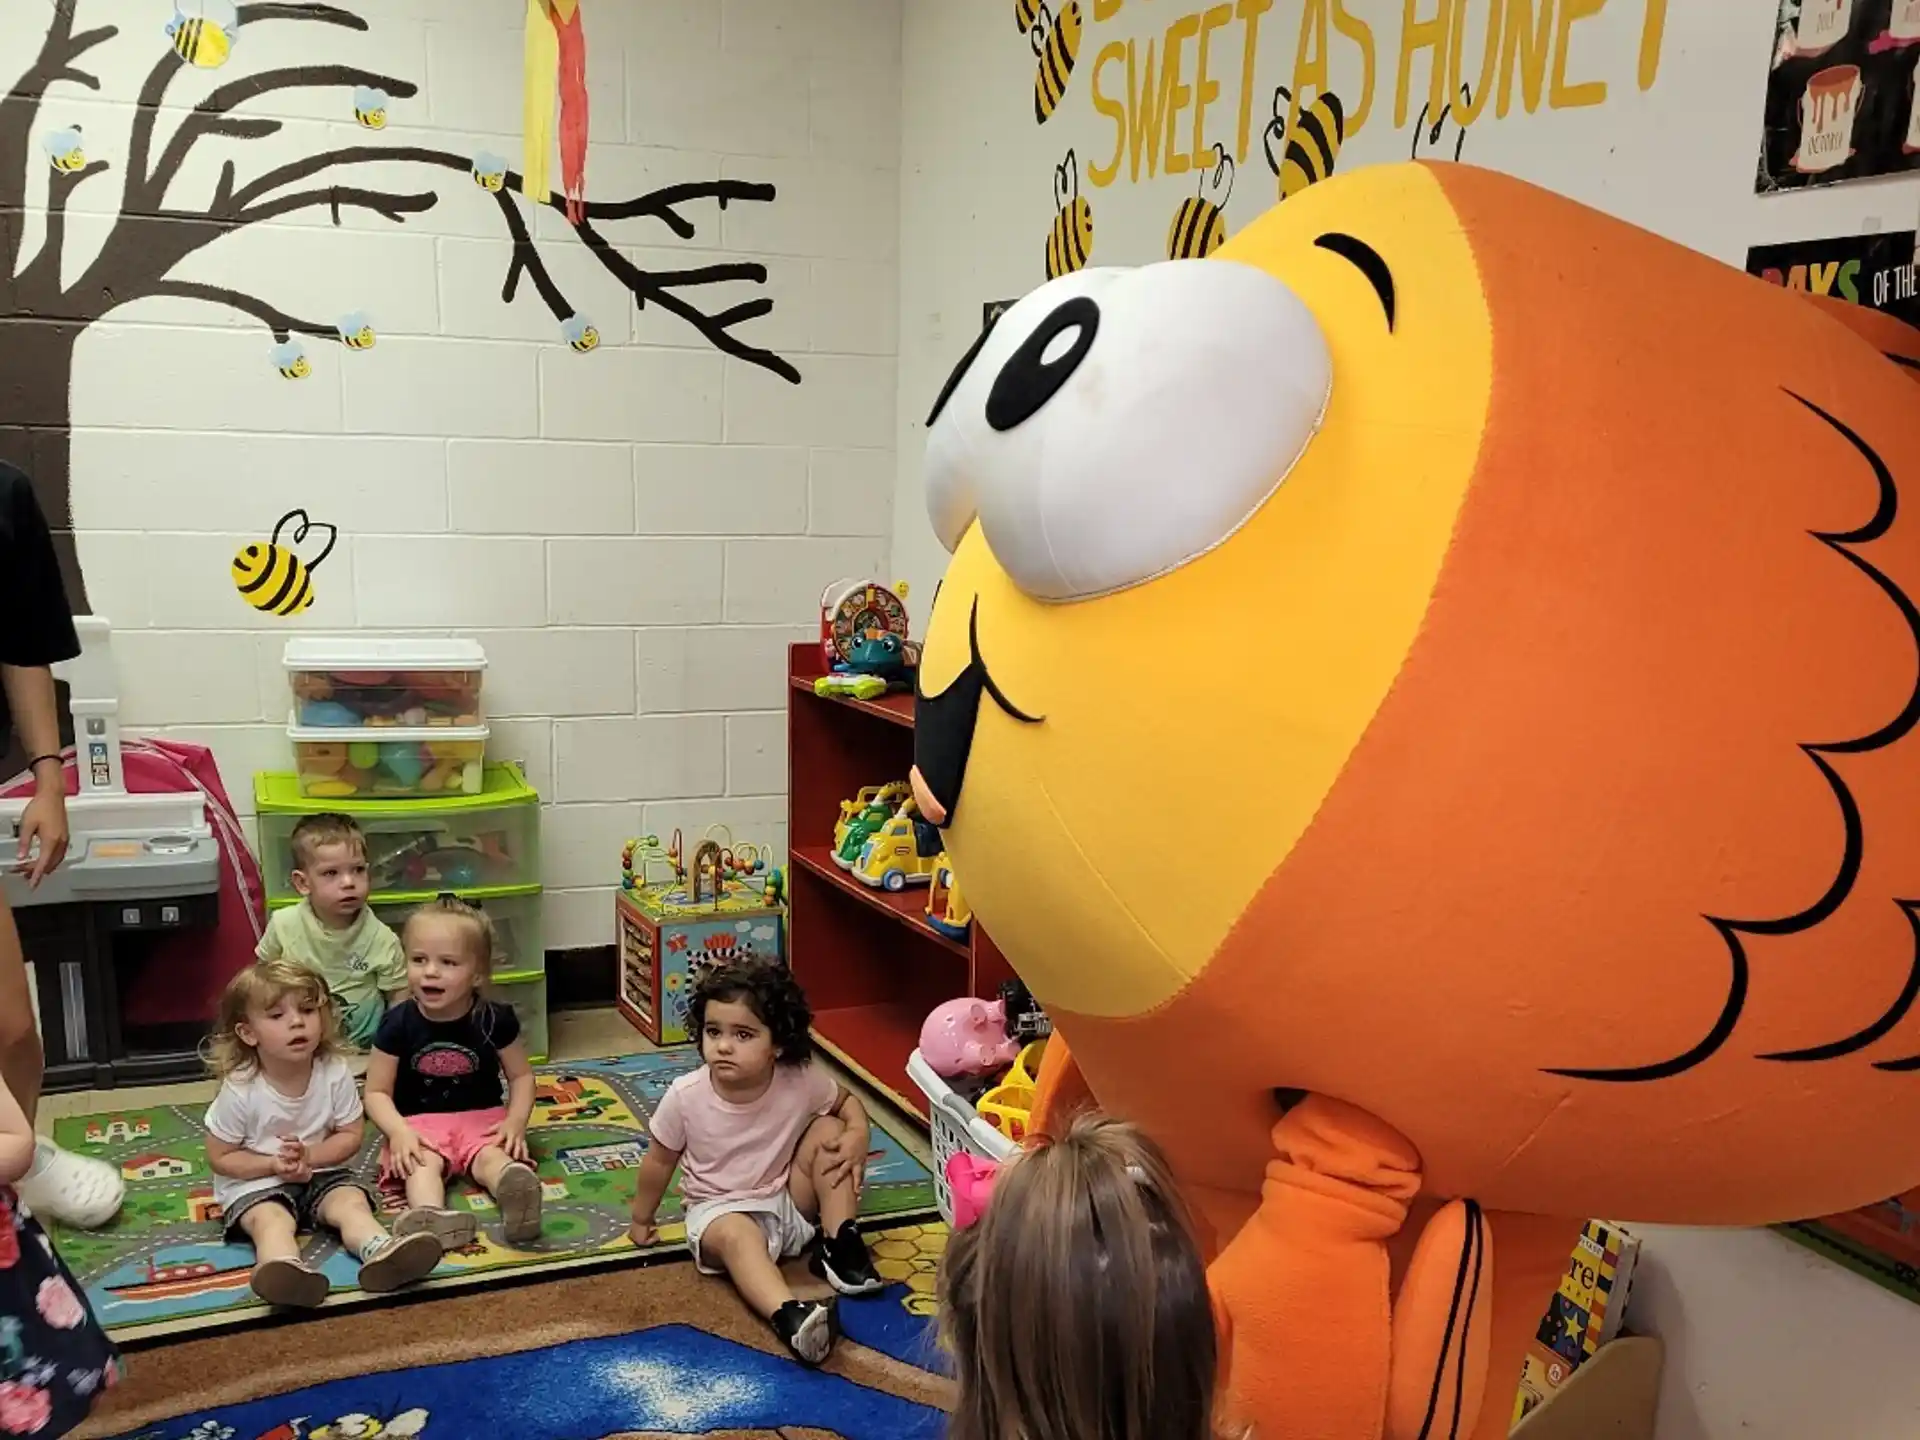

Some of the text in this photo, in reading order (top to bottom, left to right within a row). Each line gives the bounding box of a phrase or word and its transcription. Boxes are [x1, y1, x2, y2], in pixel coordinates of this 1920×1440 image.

[1088, 0, 1273, 187] SWEET
[1283, 0, 1375, 147] AS
[1873, 270, 1890, 307] OF
[1893, 264, 1918, 300] THE
